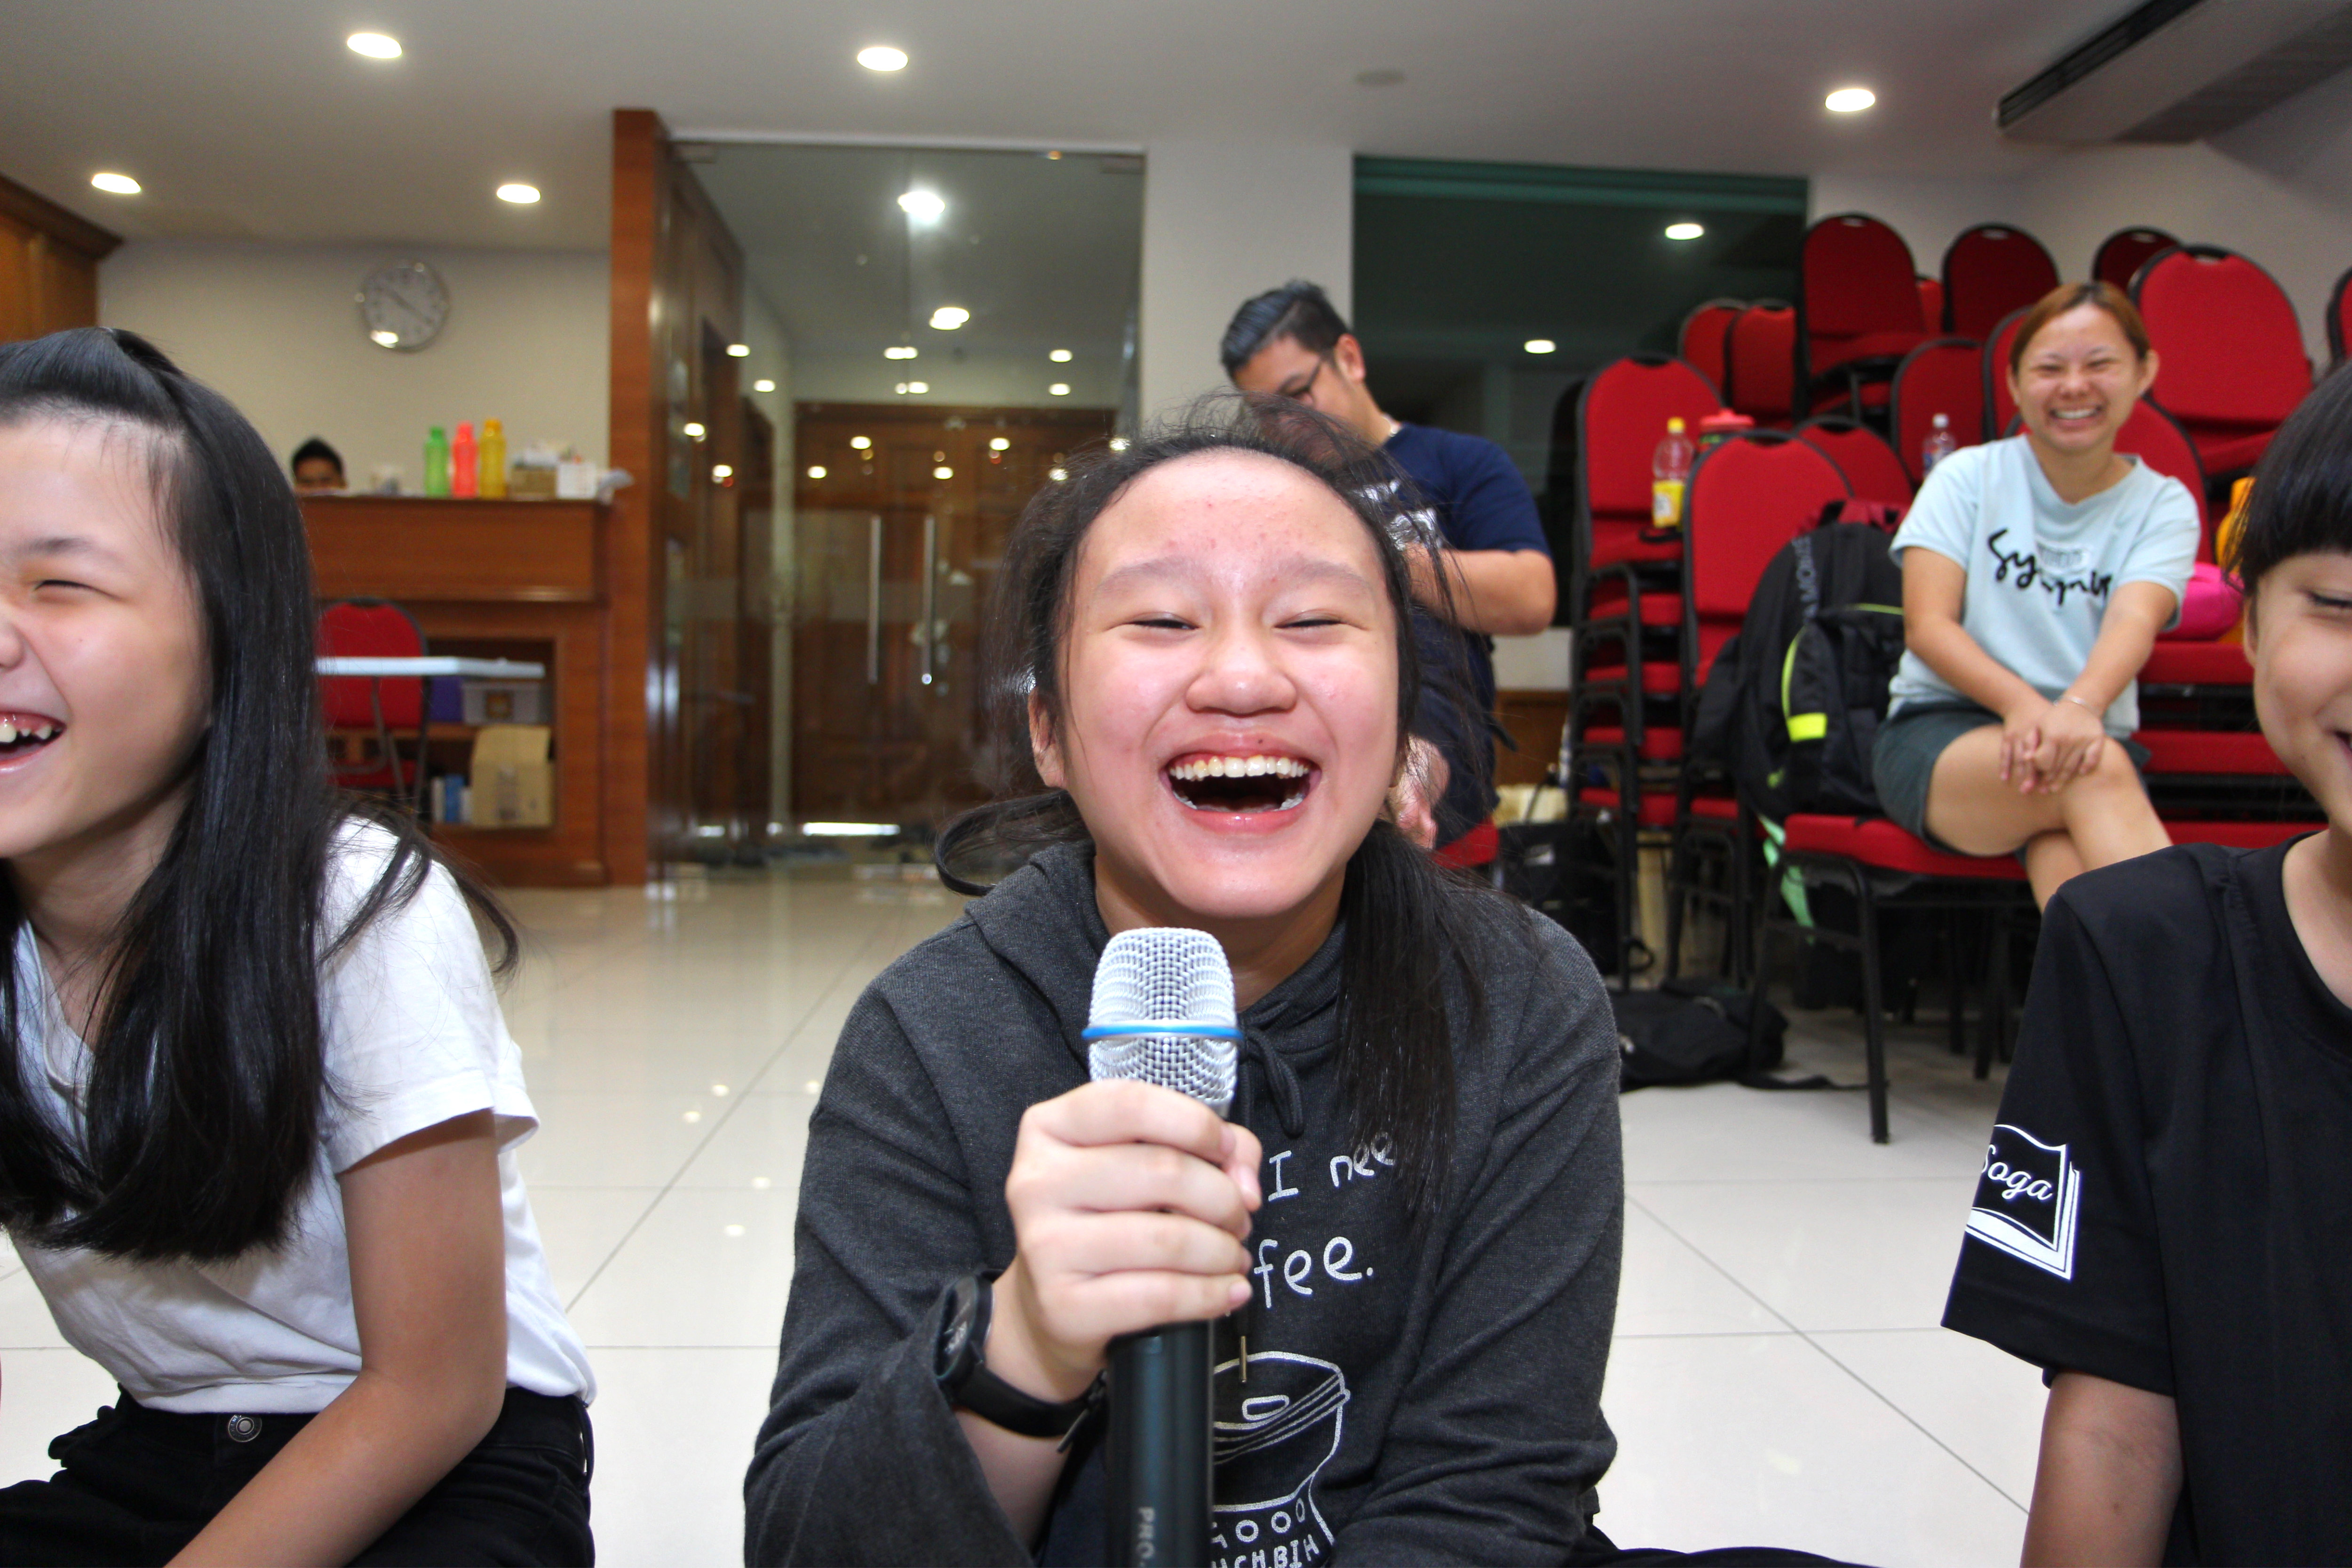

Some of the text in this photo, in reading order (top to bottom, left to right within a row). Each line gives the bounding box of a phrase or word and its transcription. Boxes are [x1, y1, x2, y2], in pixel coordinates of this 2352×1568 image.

[1268, 1131, 1396, 1202] I nee
[1254, 1236, 1373, 1308] fee.
